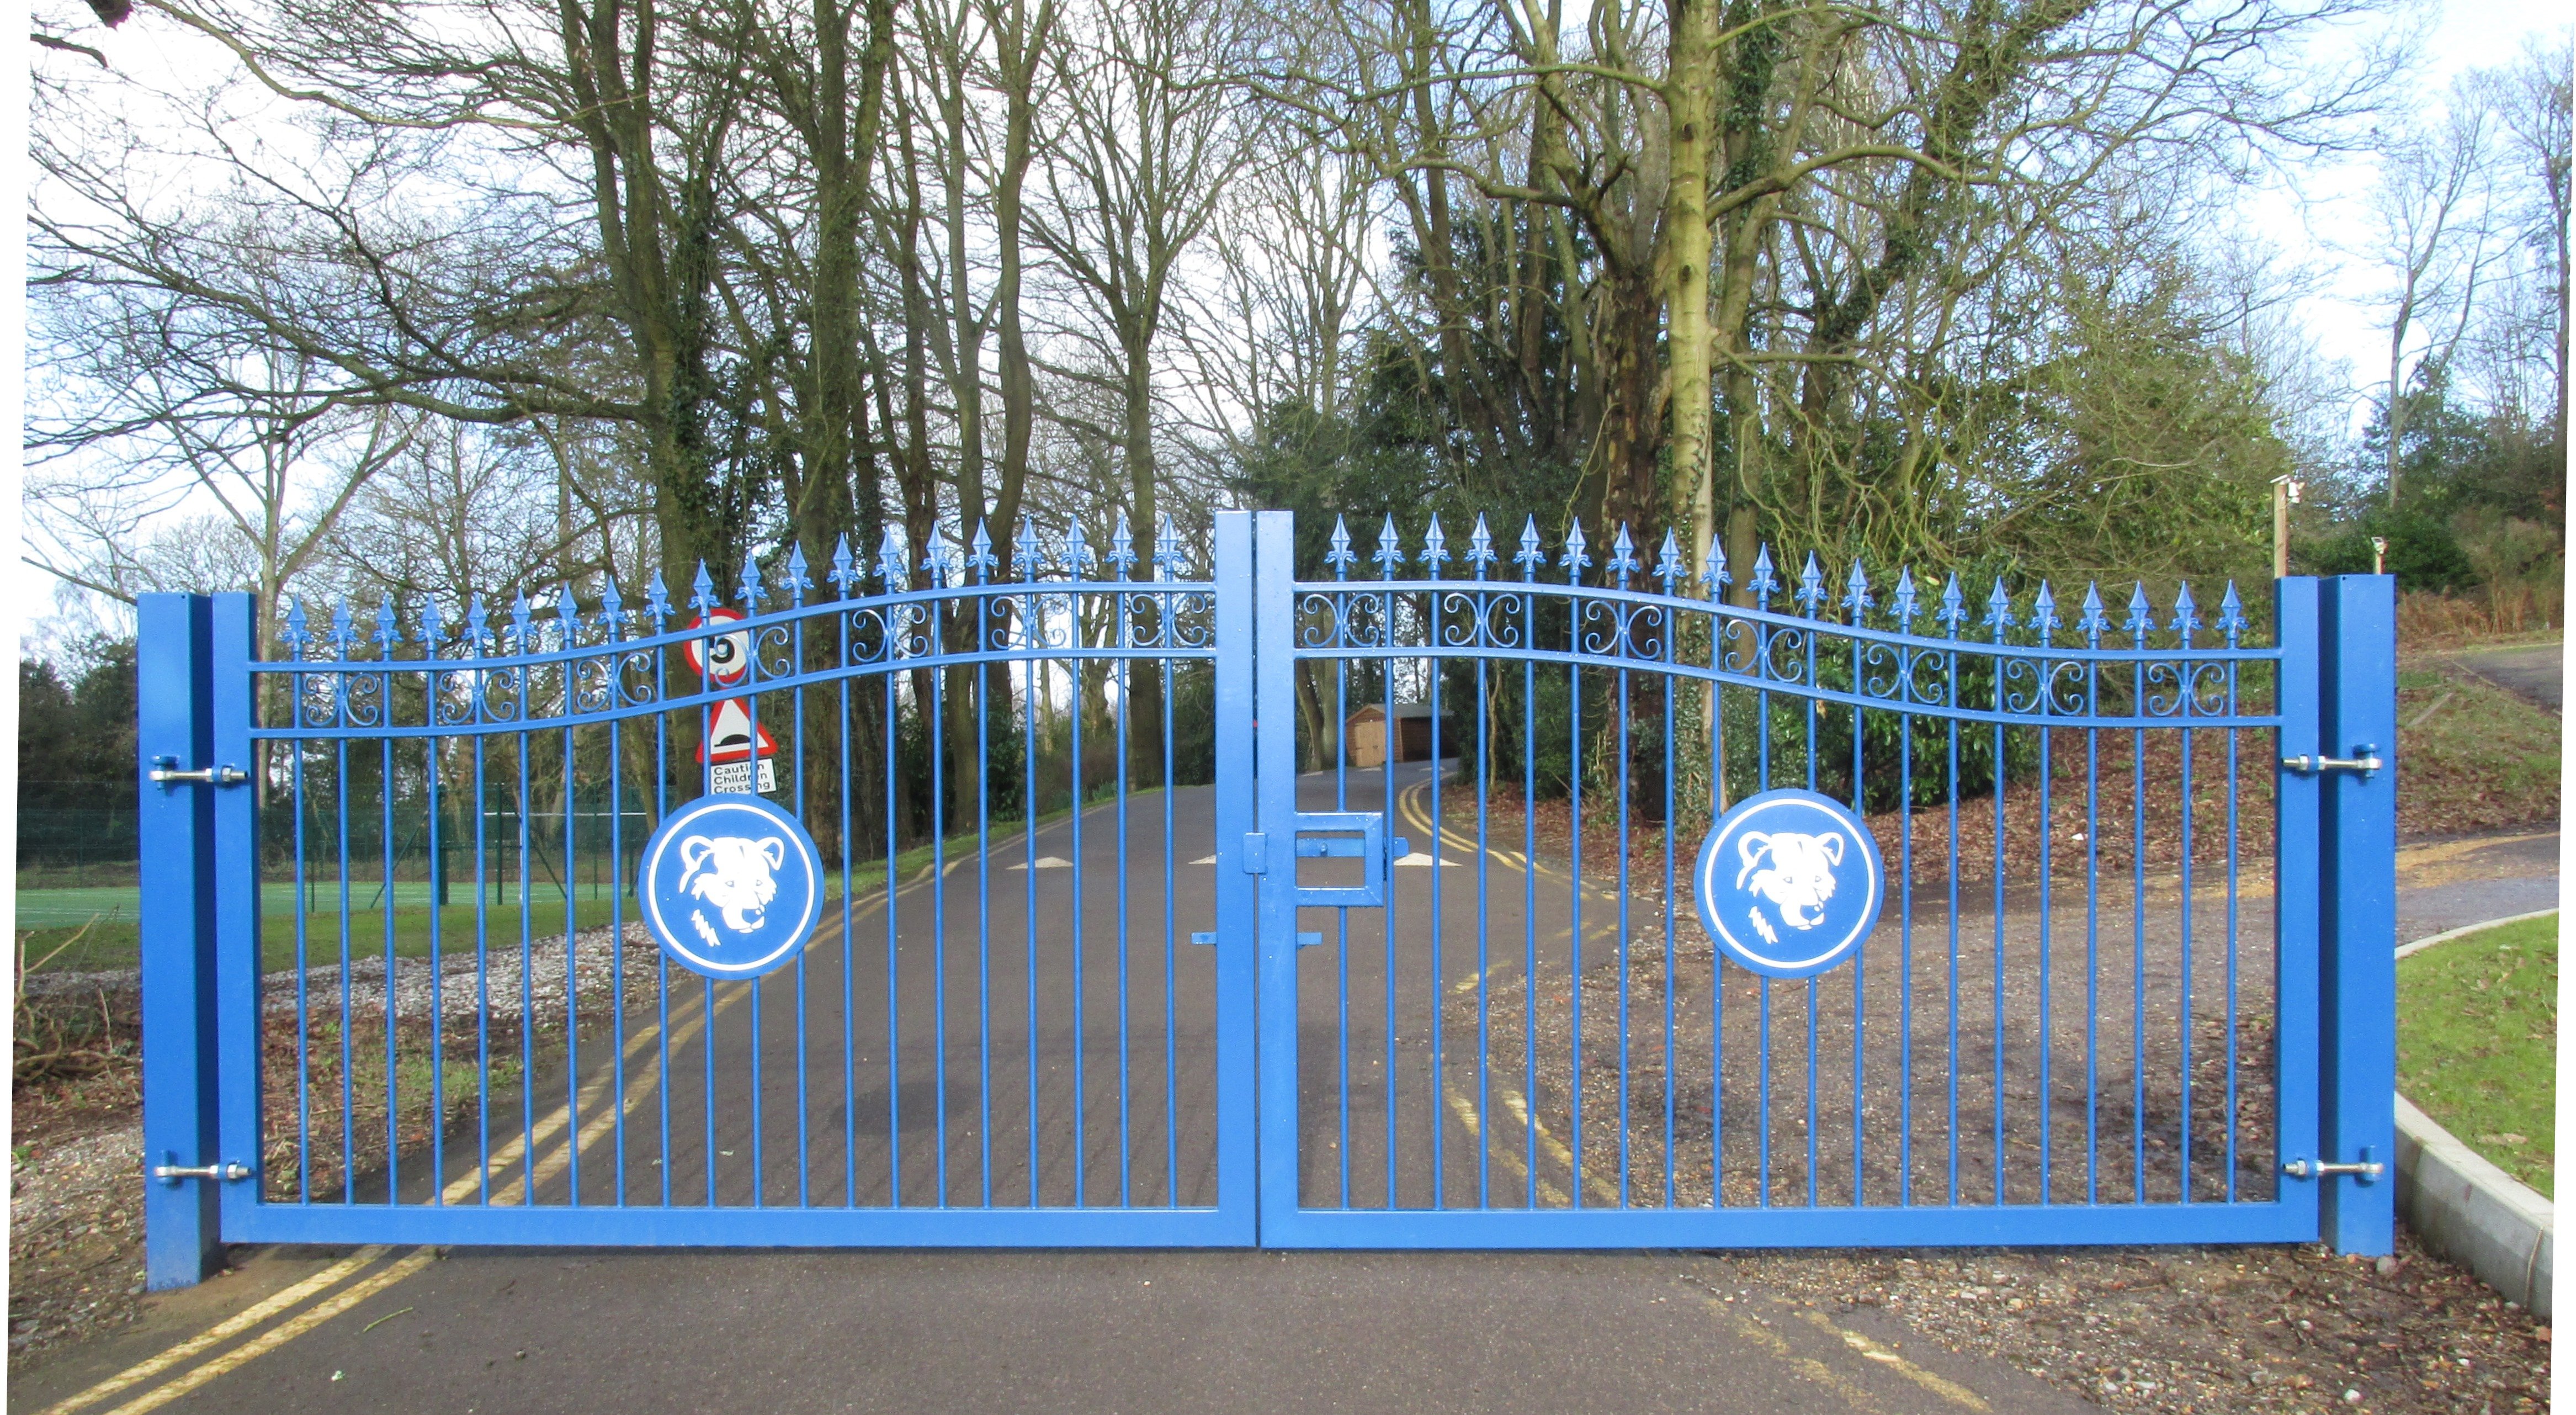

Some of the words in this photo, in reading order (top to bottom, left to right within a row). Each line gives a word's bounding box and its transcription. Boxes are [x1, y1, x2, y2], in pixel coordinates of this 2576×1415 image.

[714, 764, 764, 775] Cautin
[714, 773, 768, 785] Childrn
[714, 782, 771, 794] Crossng
